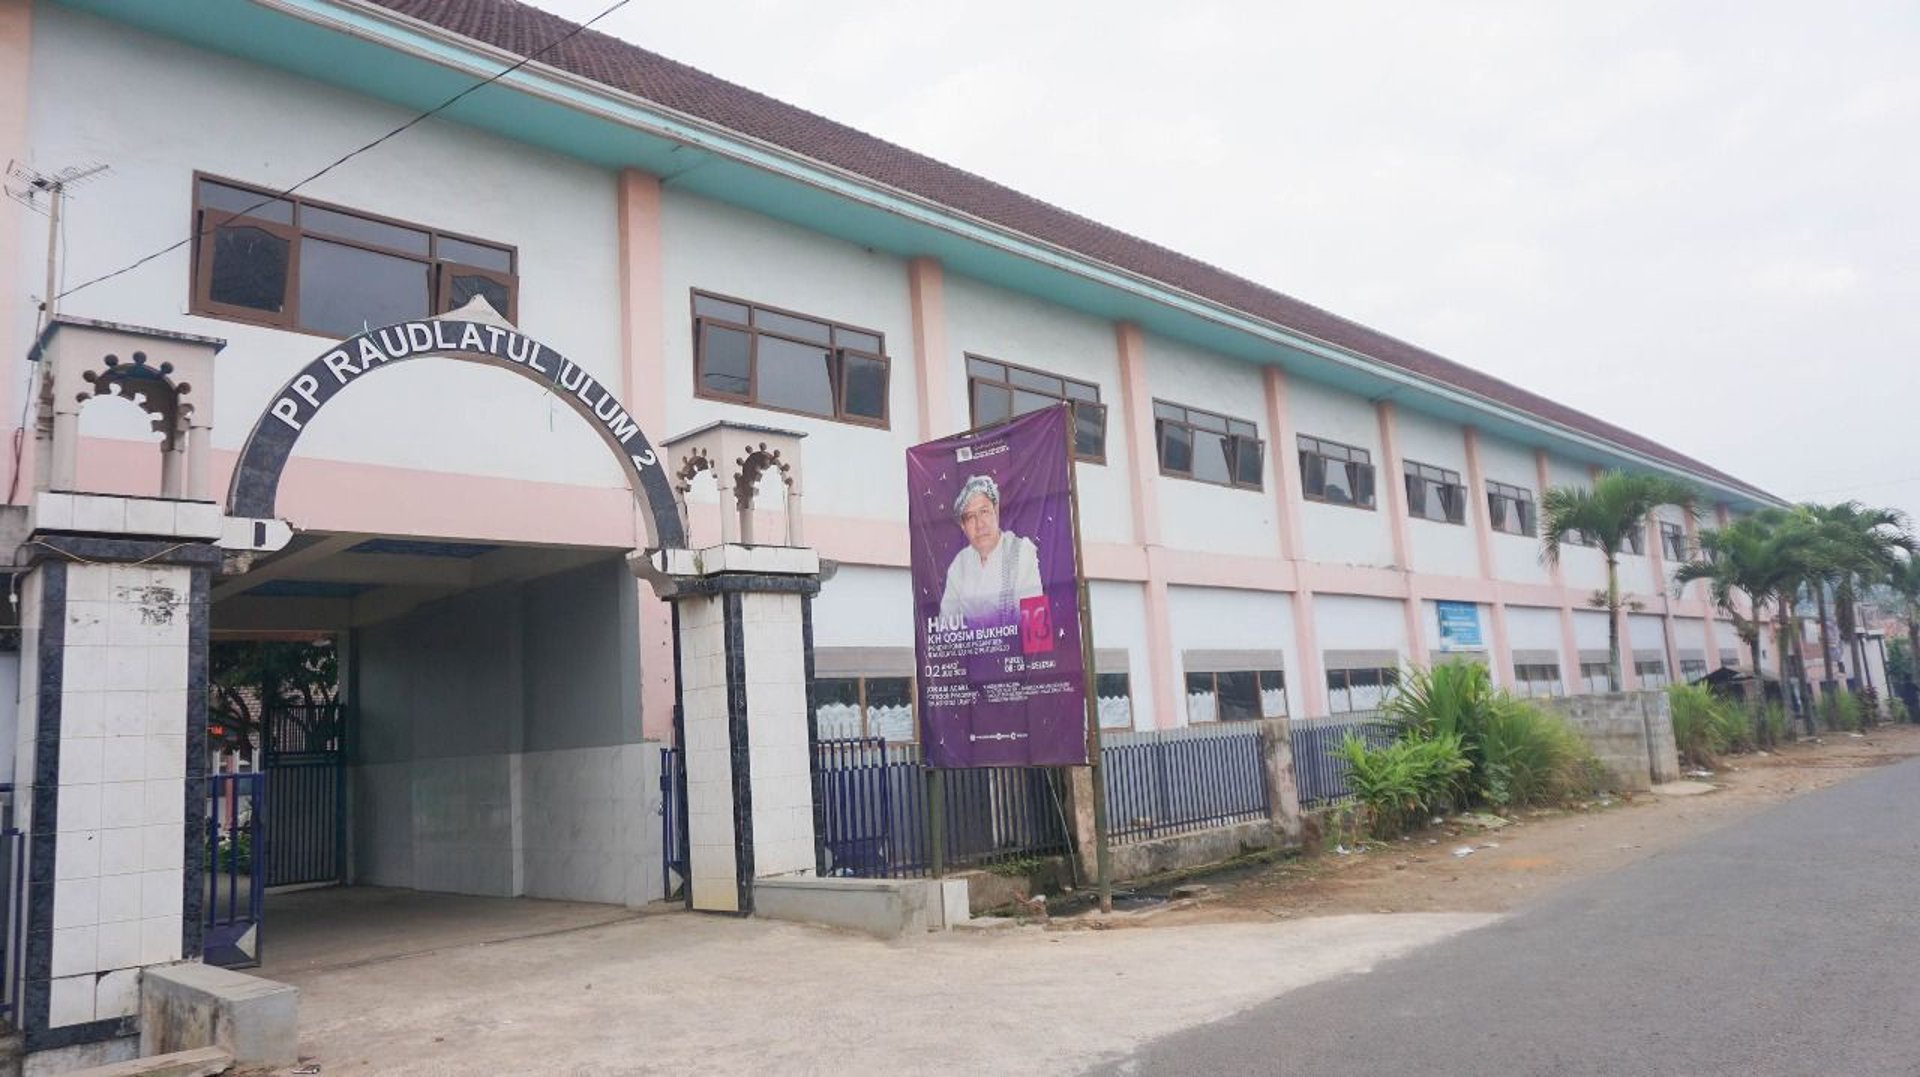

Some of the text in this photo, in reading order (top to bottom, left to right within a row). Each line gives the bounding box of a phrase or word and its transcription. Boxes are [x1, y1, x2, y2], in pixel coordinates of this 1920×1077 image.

[271, 321, 656, 471] PP RAUDLATUL ULUM 2
[927, 613, 968, 634] HAUL
[927, 633, 942, 645] KH
[975, 624, 1018, 640] BUKHORI
